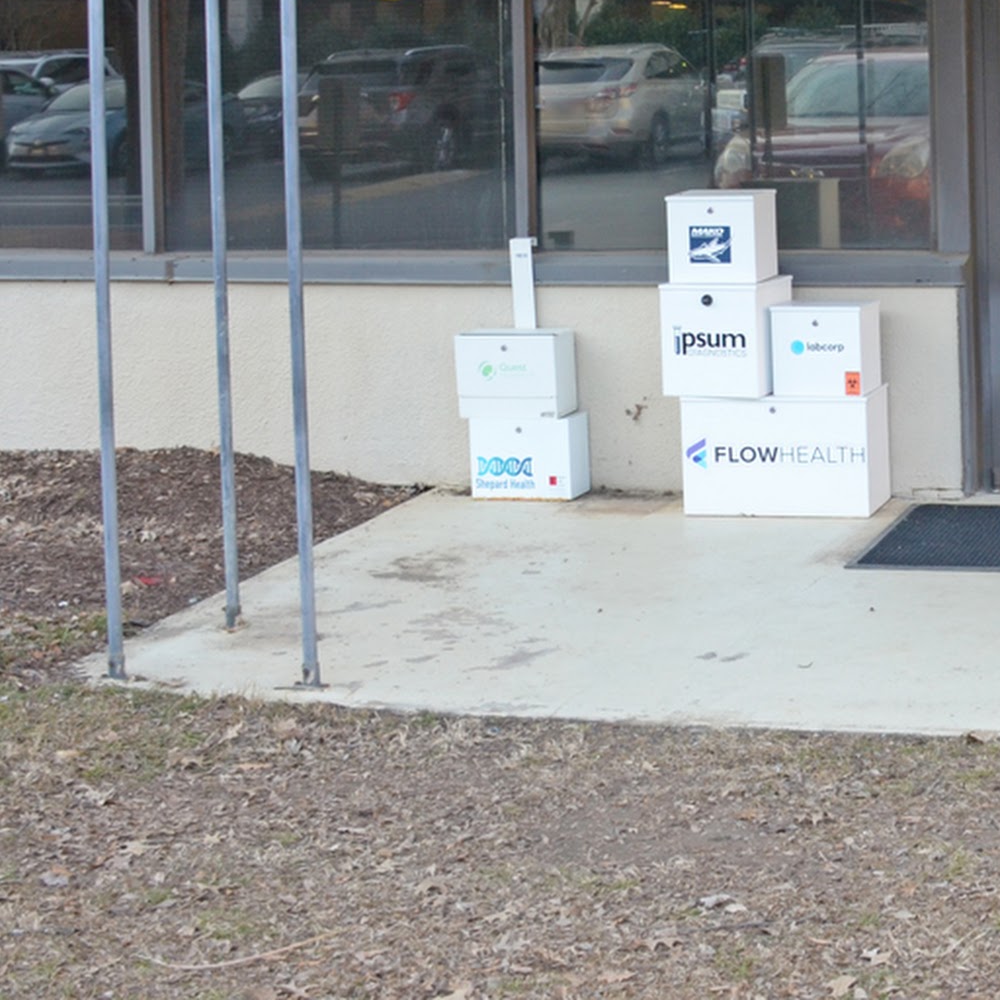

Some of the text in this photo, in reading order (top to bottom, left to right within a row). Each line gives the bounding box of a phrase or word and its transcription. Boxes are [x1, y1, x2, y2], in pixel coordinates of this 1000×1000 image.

[672, 325, 746, 355] ipsum
[806, 341, 845, 354] labcorp
[475, 478, 535, 491] Shepard Health
